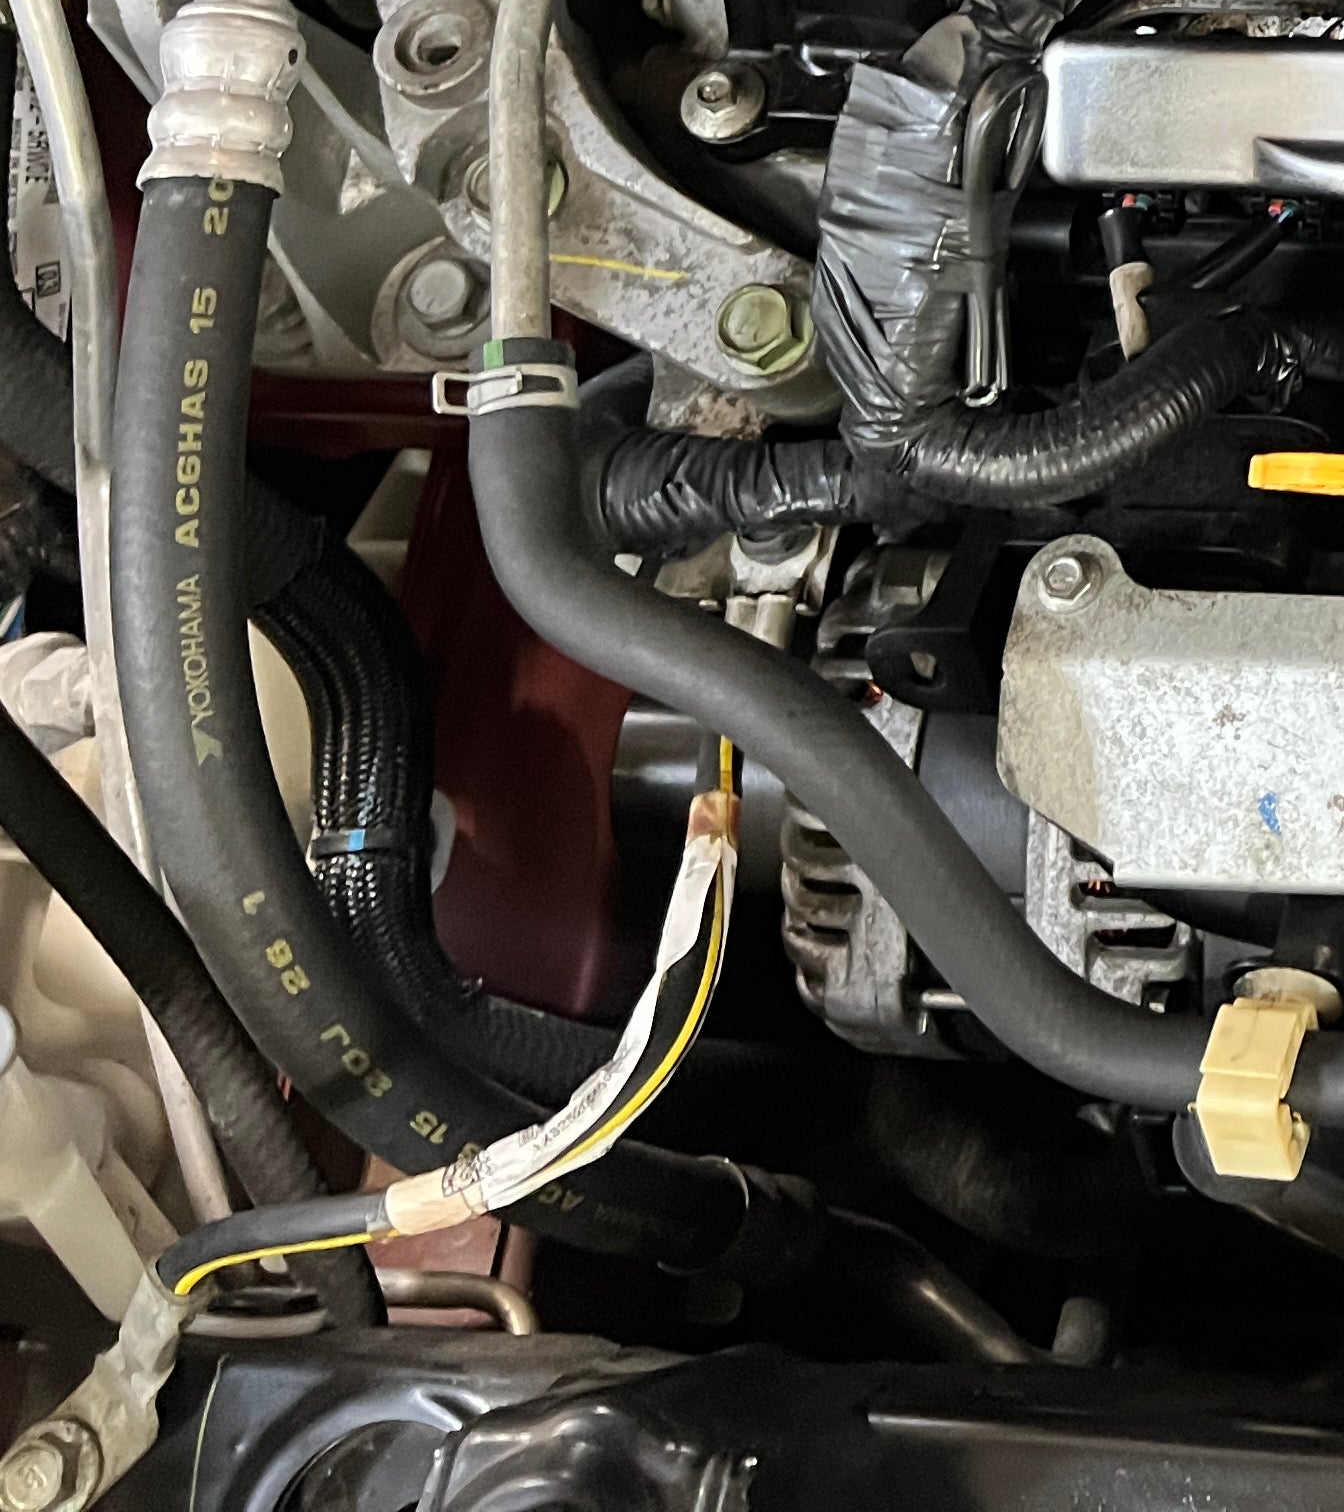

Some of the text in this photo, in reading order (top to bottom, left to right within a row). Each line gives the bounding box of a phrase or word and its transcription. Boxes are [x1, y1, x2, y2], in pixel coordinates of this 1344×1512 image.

[190, 287, 218, 334] 15
[178, 572, 214, 727] YOKOHAMA
[409, 1111, 449, 1144] 15
